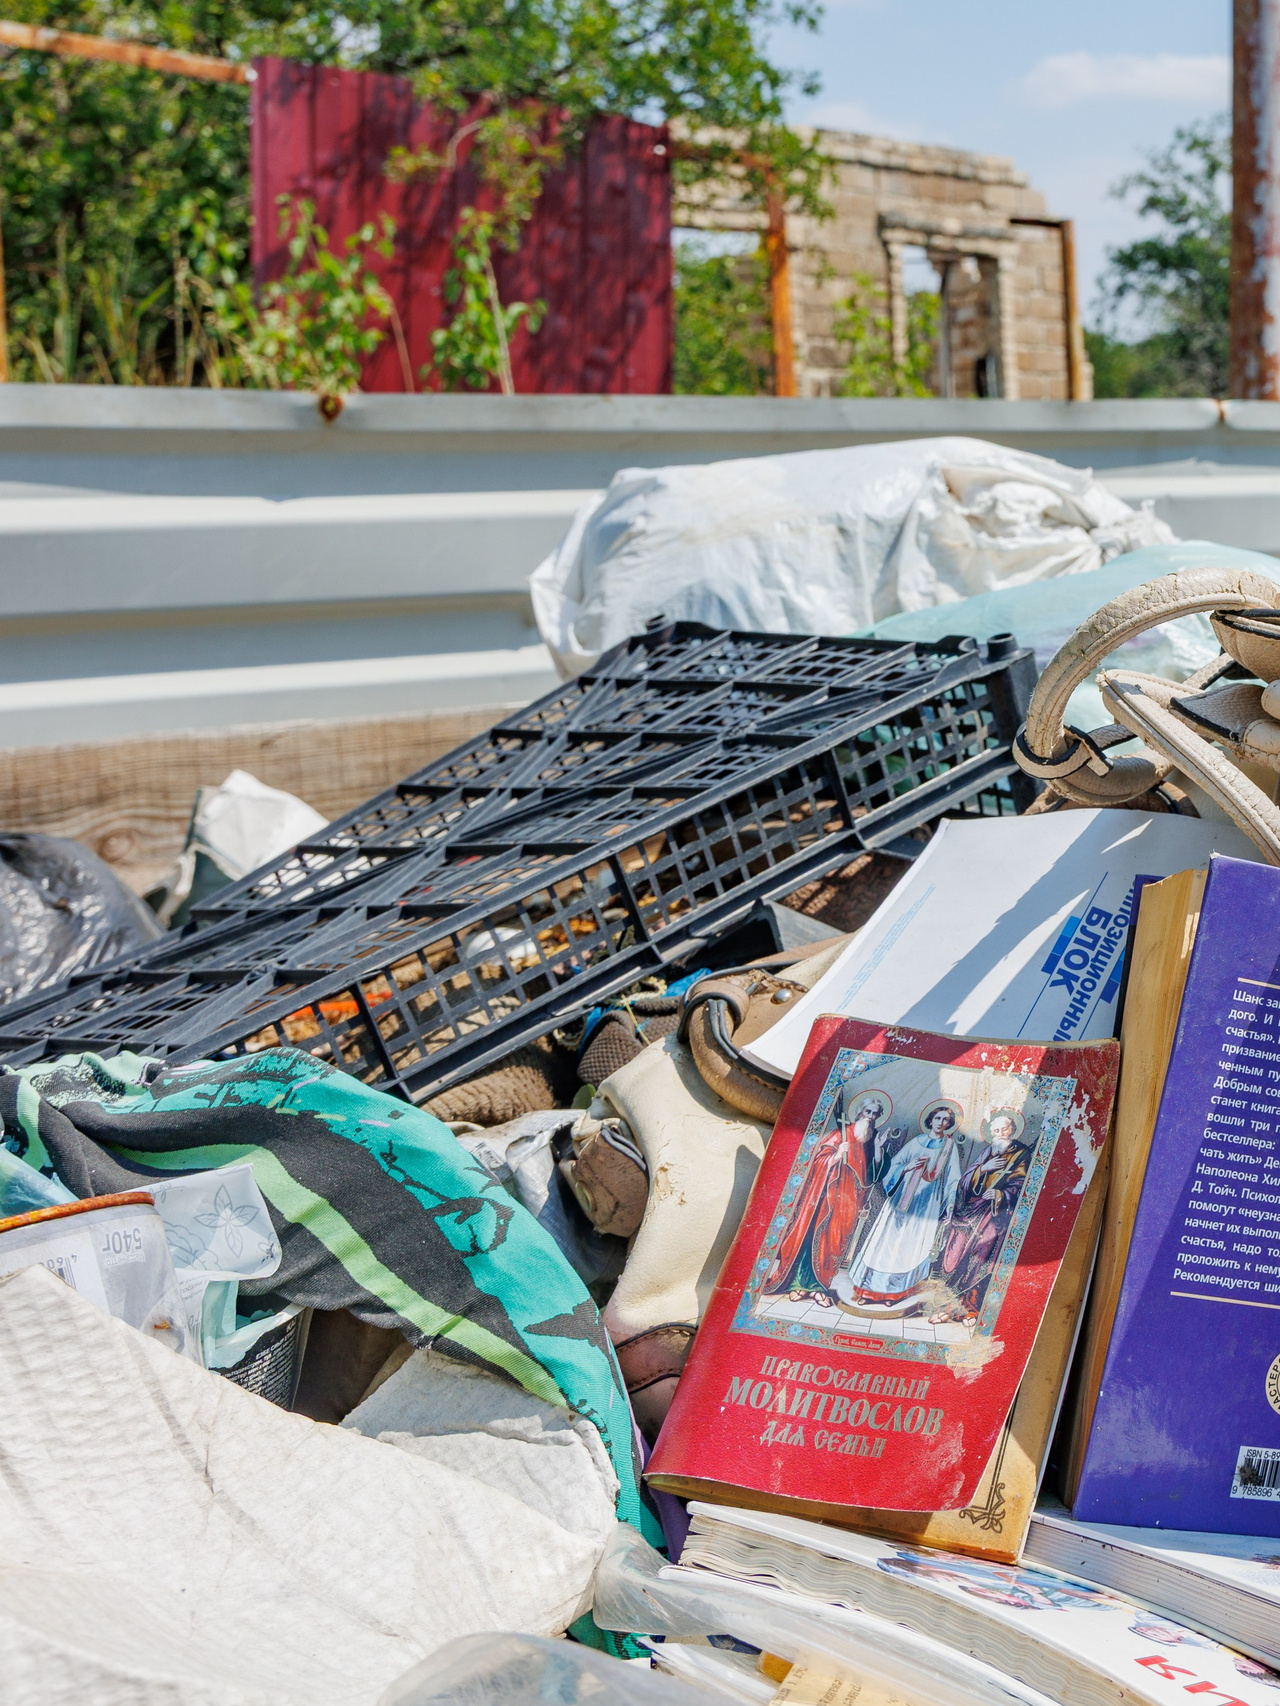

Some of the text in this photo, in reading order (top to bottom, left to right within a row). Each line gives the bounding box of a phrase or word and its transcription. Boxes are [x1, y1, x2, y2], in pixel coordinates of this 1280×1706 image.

[1049, 906, 1114, 997] БЛОК
[1232, 989, 1264, 1005] Шанс
[1227, 1009, 1258, 1022] дого.
[1263, 1013, 1273, 1025] И
[1225, 1026, 1275, 1043] счастья».
[1218, 1060, 1263, 1076] ченным
[1213, 1075, 1262, 1094] Добрым
[1210, 1095, 1248, 1109] станет
[1206, 1112, 1245, 1127] вошли
[1250, 1120, 1270, 1132] три
[1203, 1127, 1276, 1150] бестселлера:
[1200, 1147, 1225, 1159] чать
[1226, 1152, 1262, 1164] жить»
[1195, 1162, 1258, 1182] Наполеона
[1191, 1180, 1203, 1194] Д.
[1208, 1182, 1237, 1197] Тойч.
[1188, 1200, 1236, 1216] помогут
[1184, 1217, 1225, 1231] начнет
[1226, 1223, 1241, 1234] их
[1180, 1235, 1226, 1251] счастья,
[1232, 1242, 1262, 1255] надо
[1176, 1252, 1240, 1269] проложить
[1244, 1262, 1251, 1271] к
[1173, 1268, 1260, 1290] Рекомендуется
[759, 1355, 930, 1400] ПРАВОСЛАВНЫЙ
[723, 1376, 944, 1435] МОЛИТВОСЛОВ
[814, 1429, 887, 1458] СЕМЬИ
[1246, 1449, 1262, 1458] ISBN
